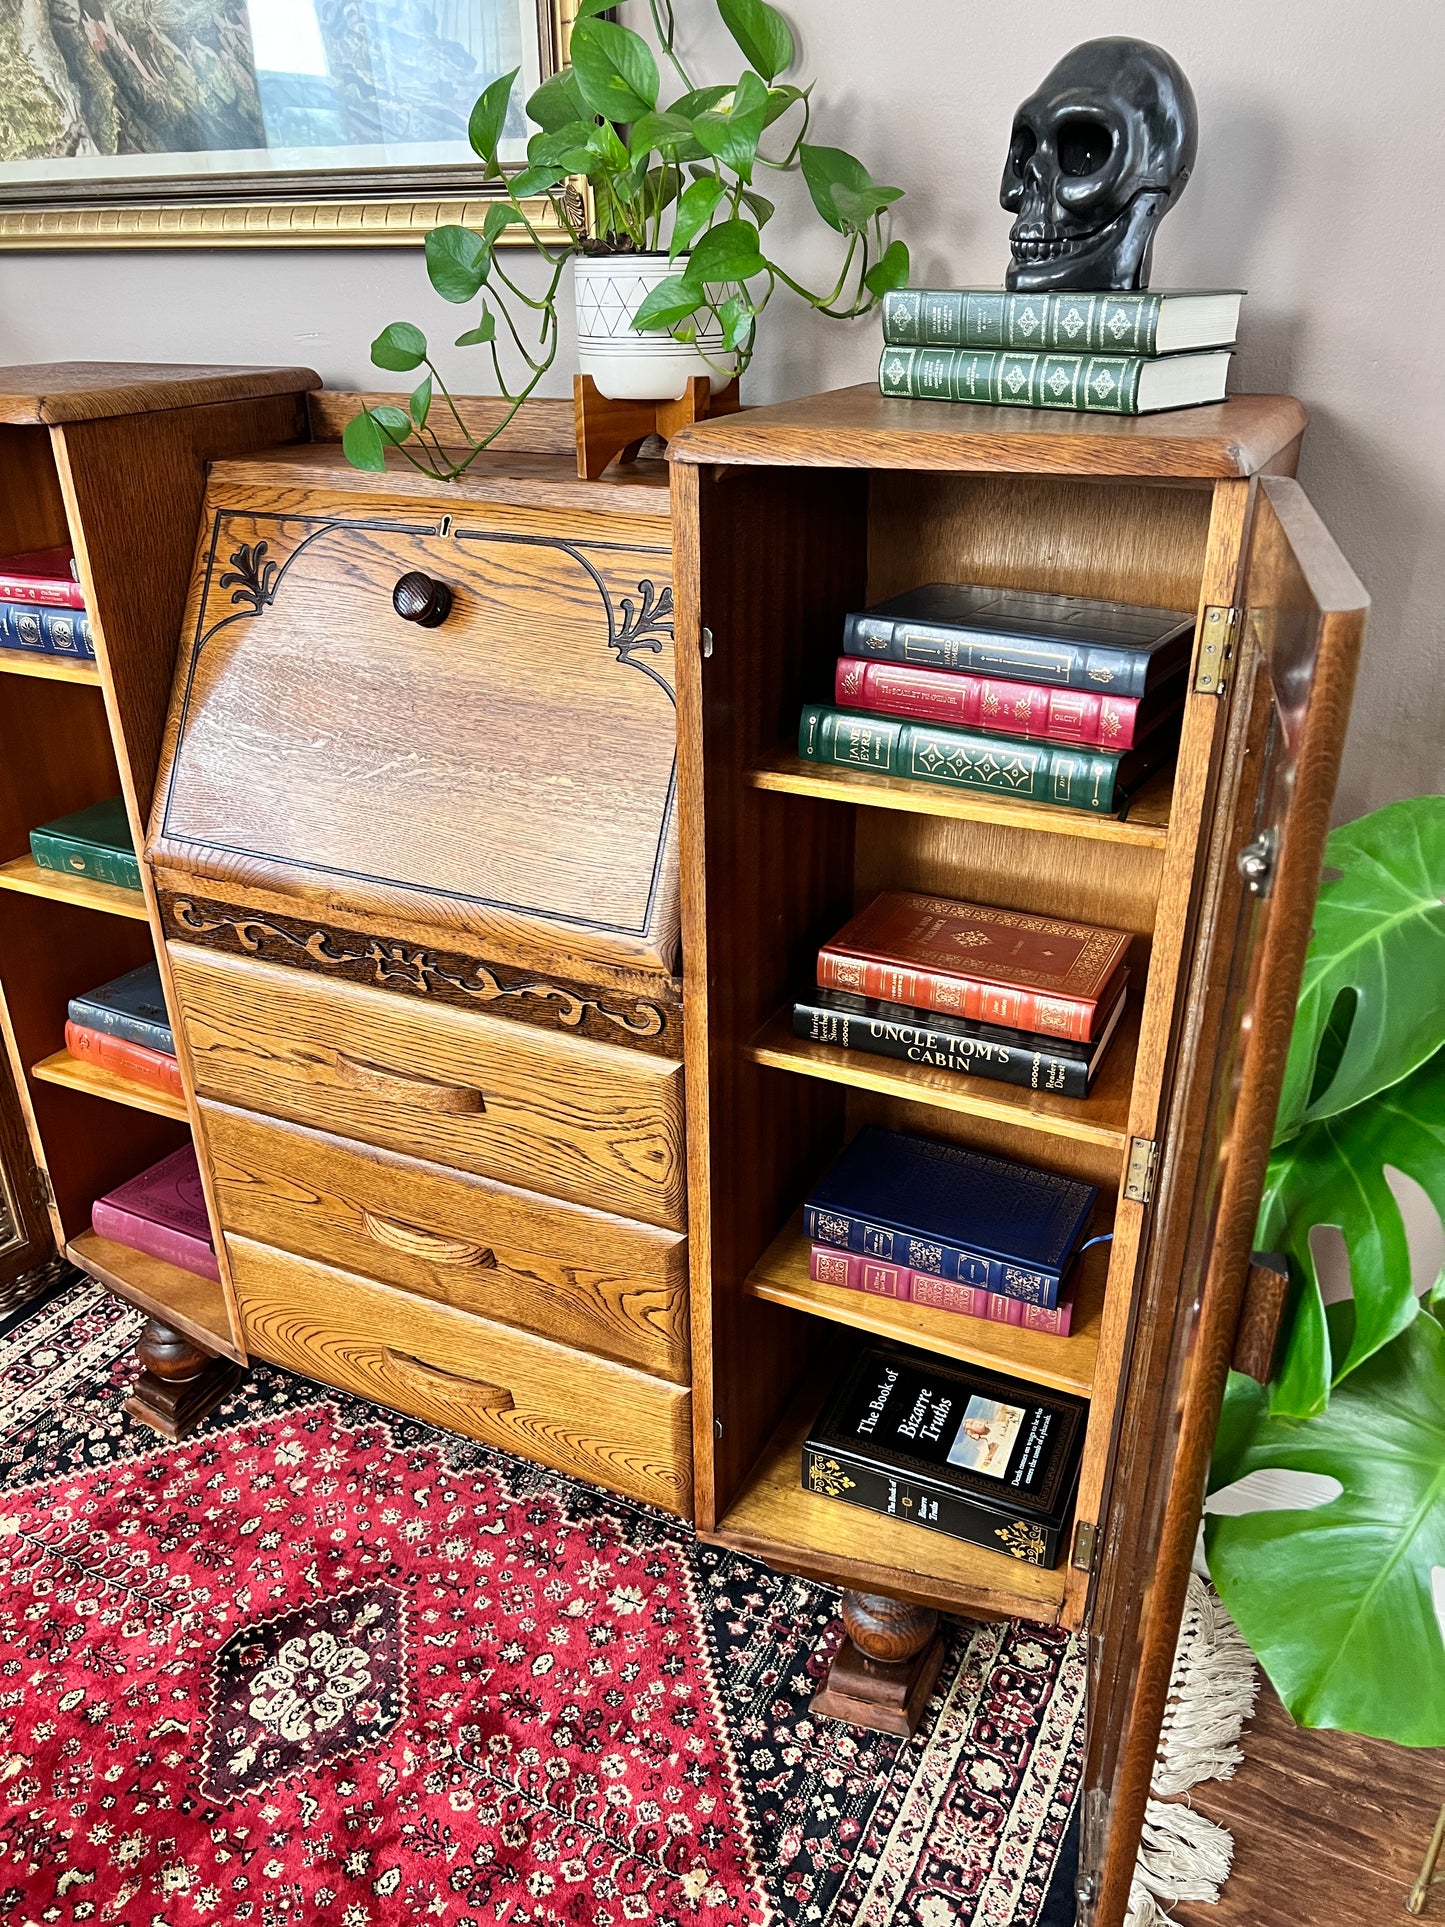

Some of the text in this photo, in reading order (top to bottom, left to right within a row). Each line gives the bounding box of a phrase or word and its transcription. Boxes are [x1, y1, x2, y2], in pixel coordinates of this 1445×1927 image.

[944, 639, 952, 666] HARD
[951, 640, 959, 667] TIMES
[849, 727, 861, 760] JANE
[860, 729, 872, 761] EYRE
[810, 1011, 819, 1039] Harriet
[828, 1017, 838, 1042] Stowe
[869, 1022, 1011, 1064] UNCLE TOM'S
[907, 1047, 971, 1072] CABIN
[1054, 1064, 1066, 1089] Digest
[857, 1367, 899, 1434] The Book of
[896, 1388, 933, 1439] Bizarre
[919, 1397, 952, 1441] Truths
[1011, 1469, 1024, 1487] Death
[1024, 1446, 1031, 1454] on
[1034, 1407, 1043, 1419] who
[1032, 1444, 1042, 1459] tomb
[1036, 1437, 1044, 1446] of
[1028, 1458, 1037, 1468] the
[887, 1478, 897, 1514] The Book of
[917, 1496, 928, 1519] Bizarre
[928, 1500, 939, 1522] Truths
